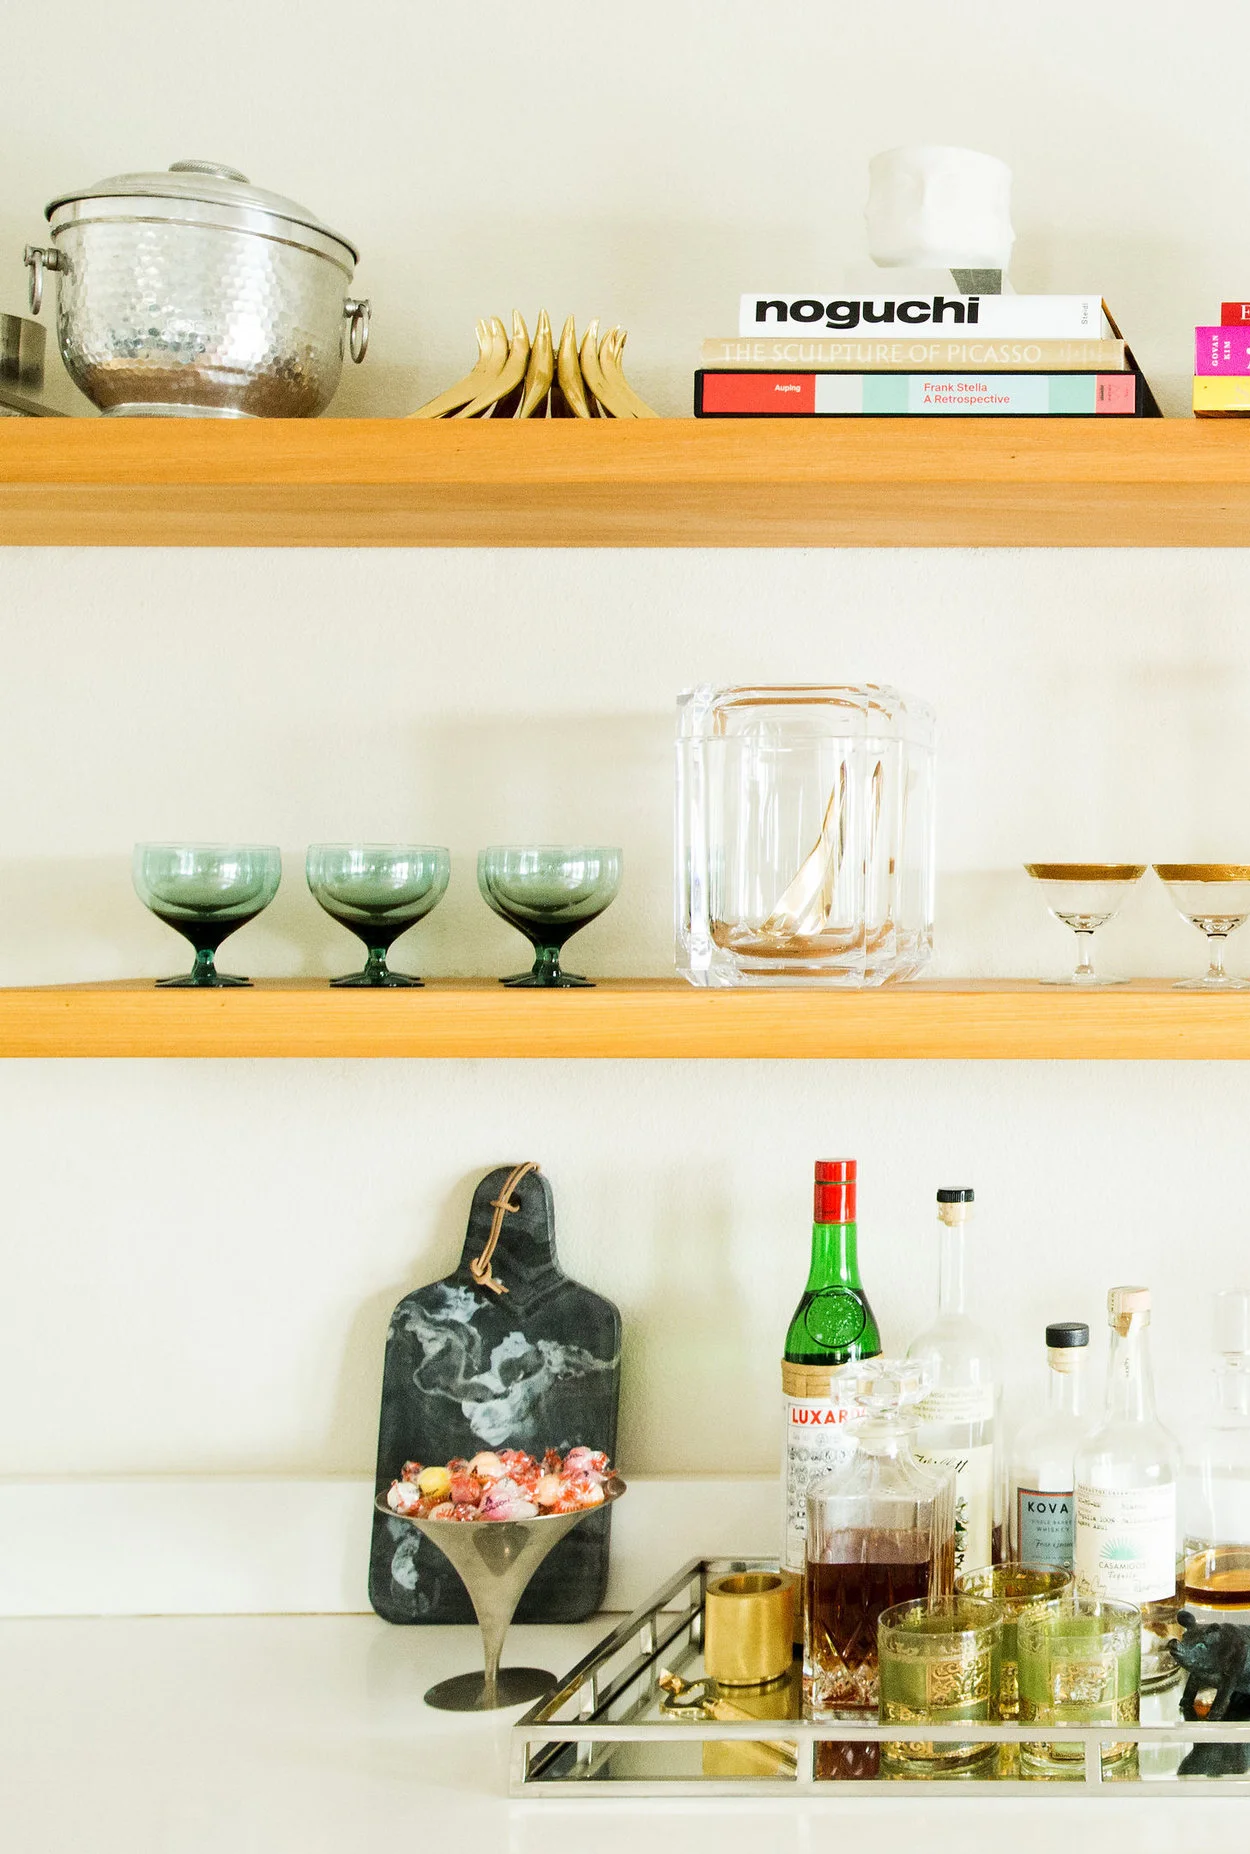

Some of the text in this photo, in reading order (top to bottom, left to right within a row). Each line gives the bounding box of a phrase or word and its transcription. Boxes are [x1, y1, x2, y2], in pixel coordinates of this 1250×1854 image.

[756, 296, 980, 329] noguchi
[721, 343, 765, 362] THE
[772, 343, 903, 362] SCULPTURE
[909, 343, 941, 362] OF
[949, 343, 1042, 362] PICASSO
[1211, 335, 1219, 367] GOVAN
[1223, 340, 1232, 361] KIM
[774, 384, 801, 393] Auping
[923, 382, 988, 392] Frank Stella
[923, 394, 1010, 406] A Retrospective
[792, 1406, 867, 1425] LUXAR
[1027, 1501, 1069, 1513] KOVA
